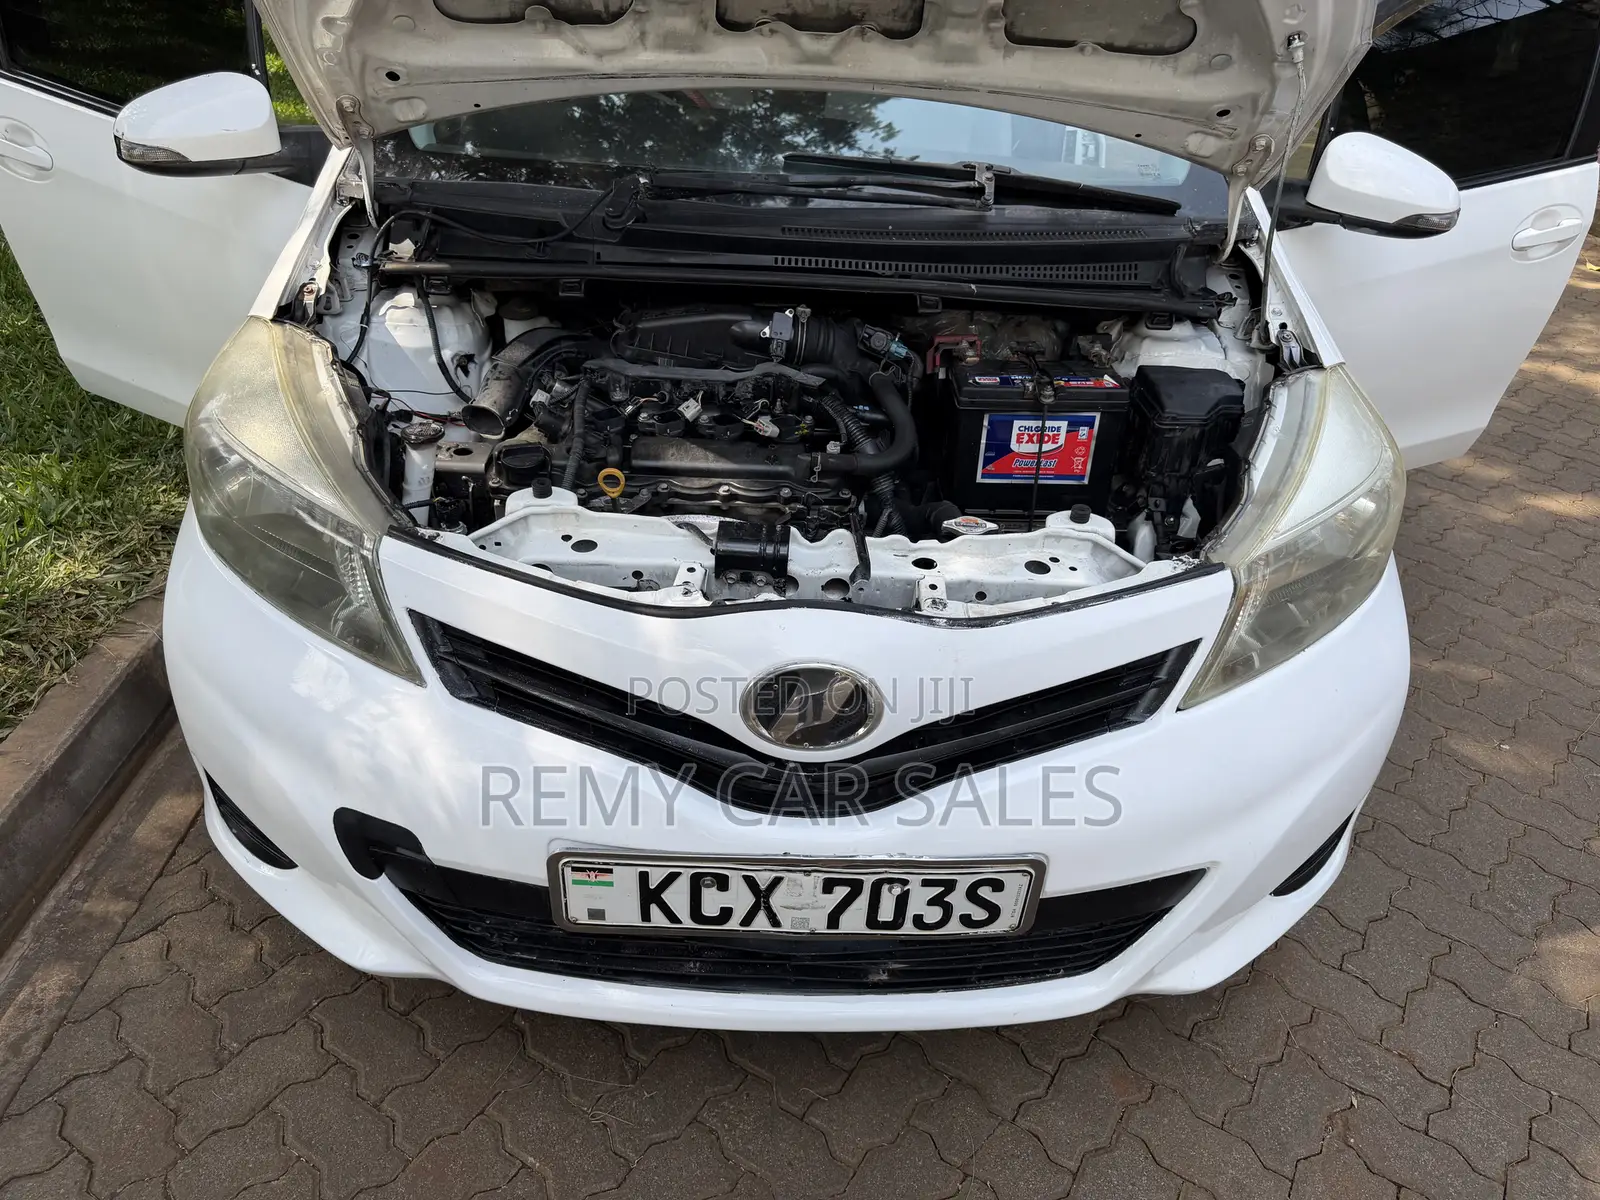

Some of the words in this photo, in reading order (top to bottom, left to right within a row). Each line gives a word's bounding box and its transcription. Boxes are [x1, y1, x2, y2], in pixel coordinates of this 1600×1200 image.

[1018, 425, 1062, 433] CHLORIDE
[1016, 432, 1061, 444] EXIDE
[638, 870, 784, 927] KCX
[821, 877, 1005, 931] 703S
